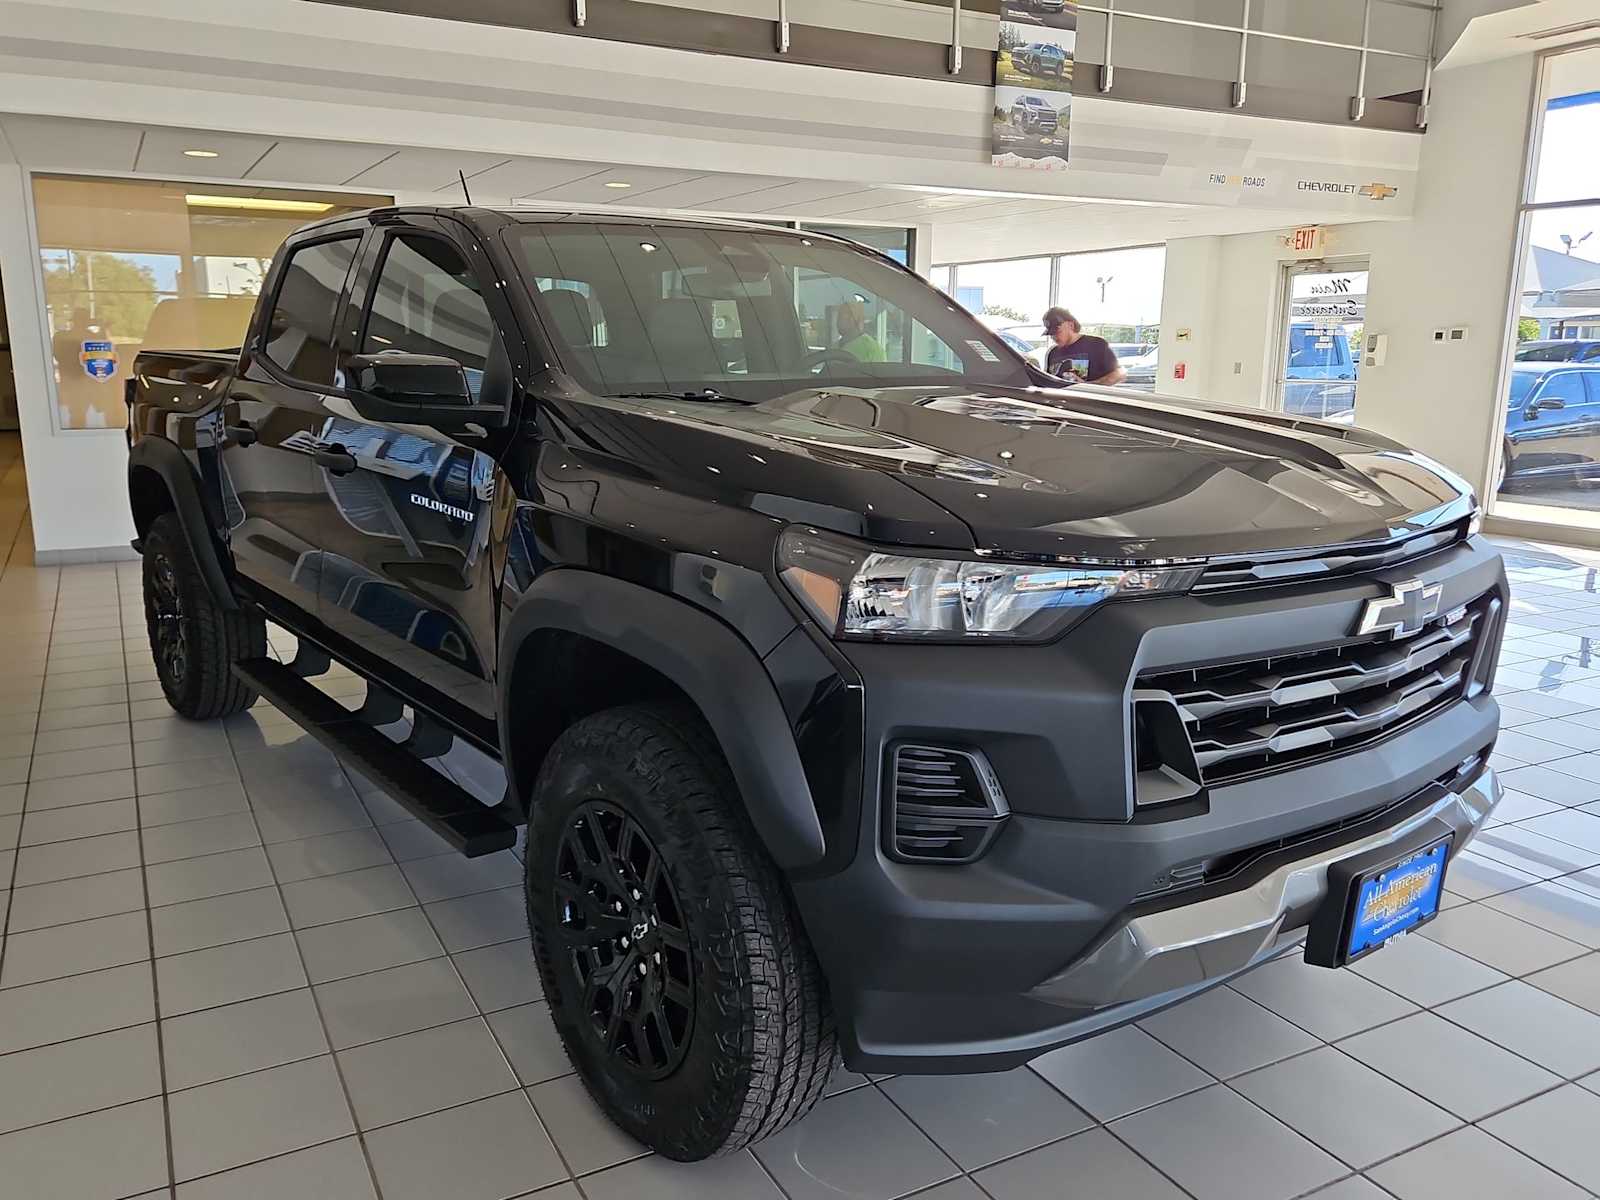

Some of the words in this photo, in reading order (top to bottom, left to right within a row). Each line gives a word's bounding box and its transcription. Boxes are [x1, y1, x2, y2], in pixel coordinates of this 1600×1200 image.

[1209, 173, 1225, 185] FIND
[1243, 176, 1266, 188] ROADS
[1297, 180, 1356, 194] CHEVROLET
[1295, 229, 1316, 250] EXIT
[410, 493, 474, 522] COLORADO
